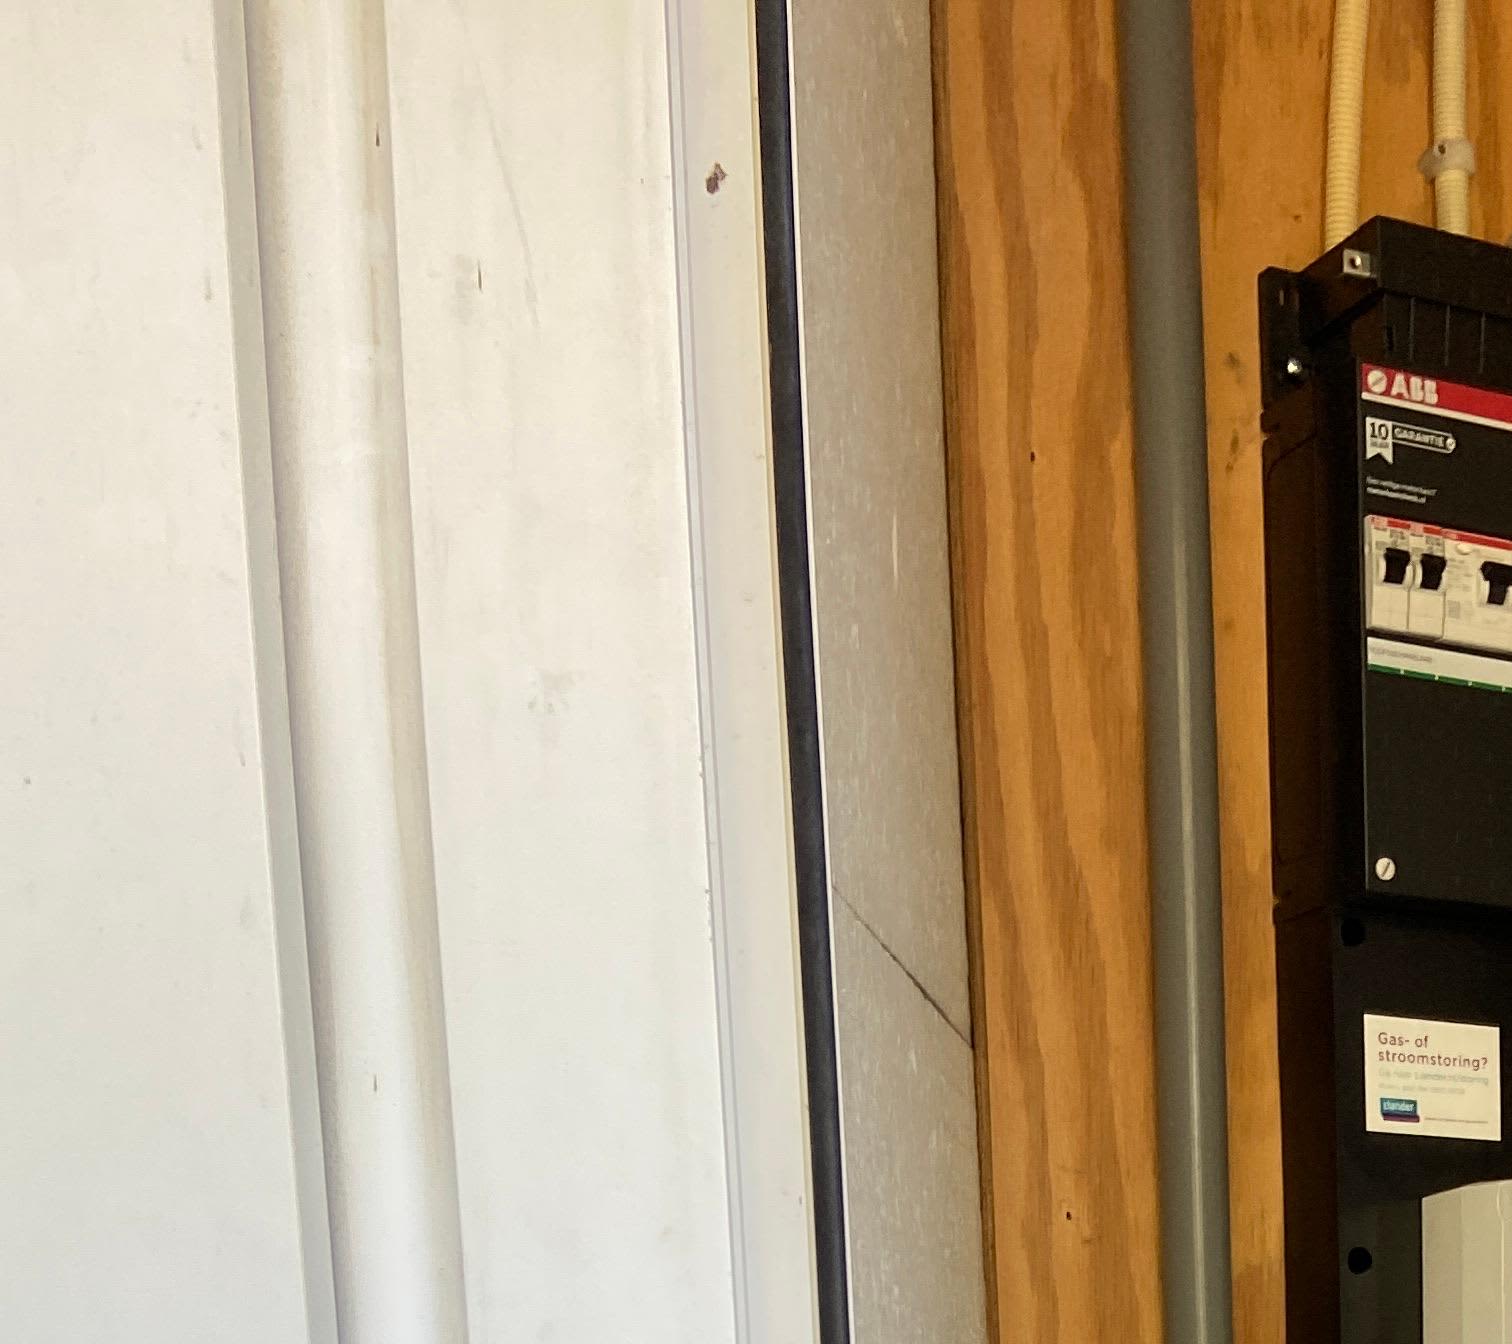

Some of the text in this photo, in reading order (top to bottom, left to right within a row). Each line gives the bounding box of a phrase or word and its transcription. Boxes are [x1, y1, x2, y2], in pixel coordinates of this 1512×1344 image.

[1390, 371, 1439, 405] ABB
[1369, 421, 1389, 441] 10
[1377, 1031, 1429, 1048] Gas- of
[1377, 1050, 1489, 1072] stroomstoring?
